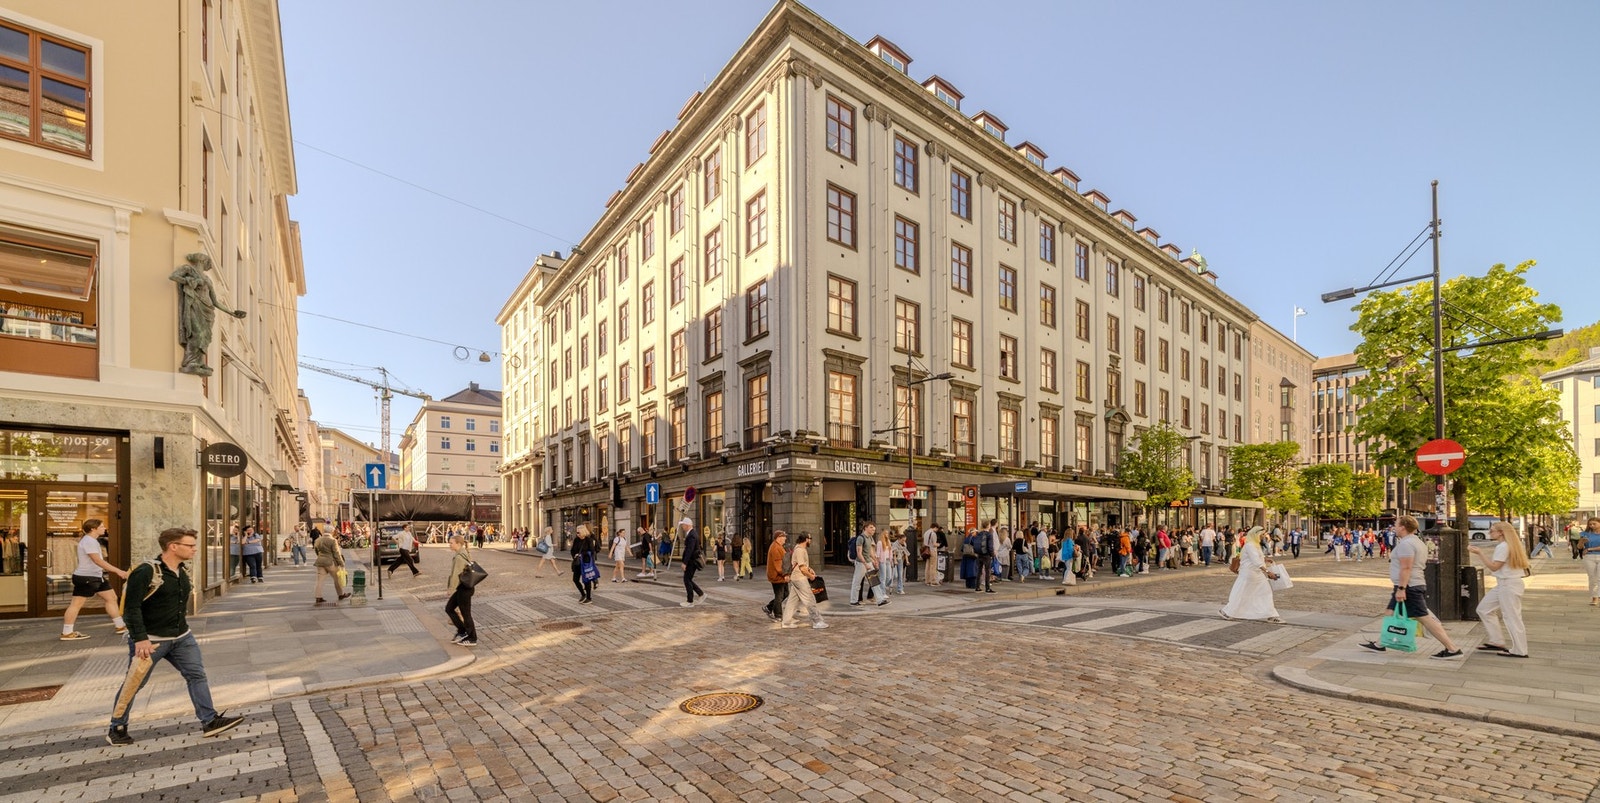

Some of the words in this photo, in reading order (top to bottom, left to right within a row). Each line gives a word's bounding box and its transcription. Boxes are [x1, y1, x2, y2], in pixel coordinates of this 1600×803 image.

[208, 454, 240, 464] RETRO
[738, 461, 765, 477] GALLERIET
[834, 460, 871, 475] GALLERIET
